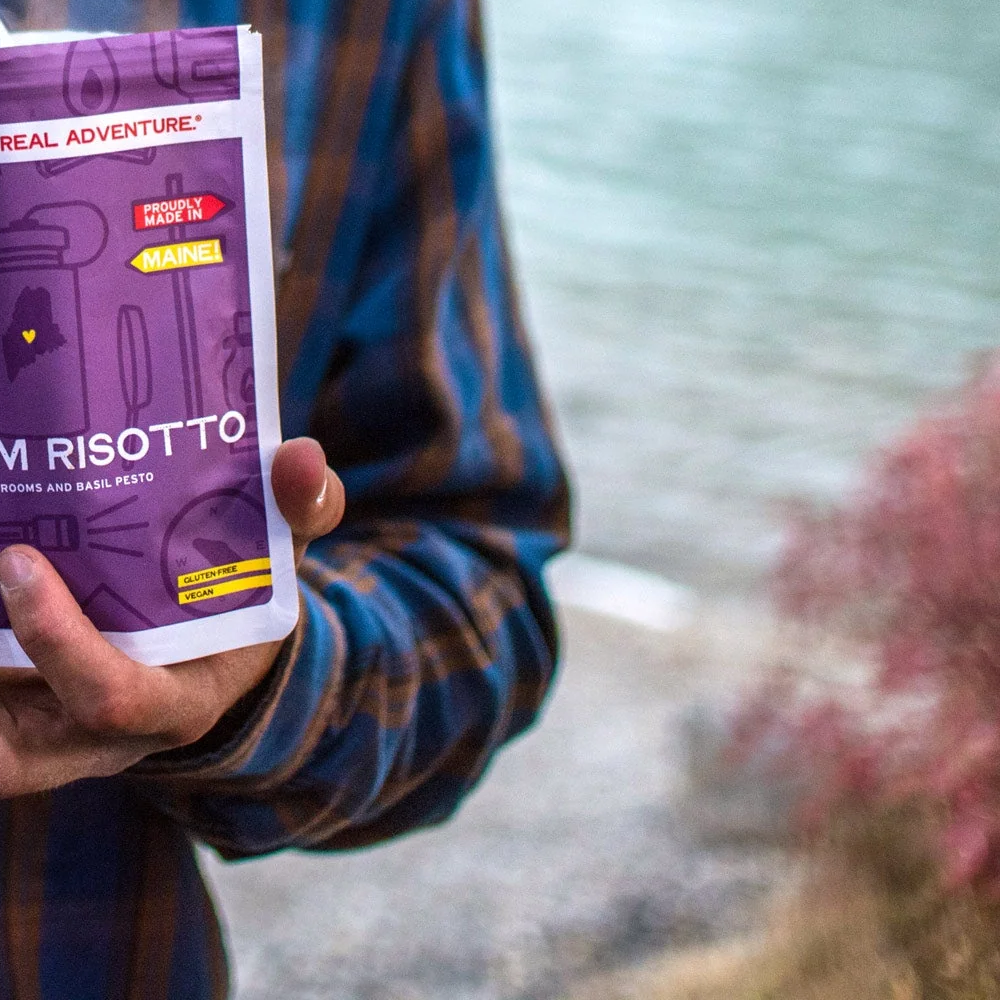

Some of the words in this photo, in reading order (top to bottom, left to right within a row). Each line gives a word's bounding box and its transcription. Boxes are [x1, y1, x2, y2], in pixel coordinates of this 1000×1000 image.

[0, 132, 60, 152] REAL
[143, 197, 202, 215] PROUDLY
[144, 210, 184, 227] MADE
[187, 208, 203, 221] IN
[142, 240, 221, 270] MAINE!
[47, 410, 247, 472] RISOTTO
[46, 482, 73, 492] AND
[76, 478, 112, 492] BASIL
[115, 472, 155, 487] PESTO
[184, 588, 214, 601] VEGAN
